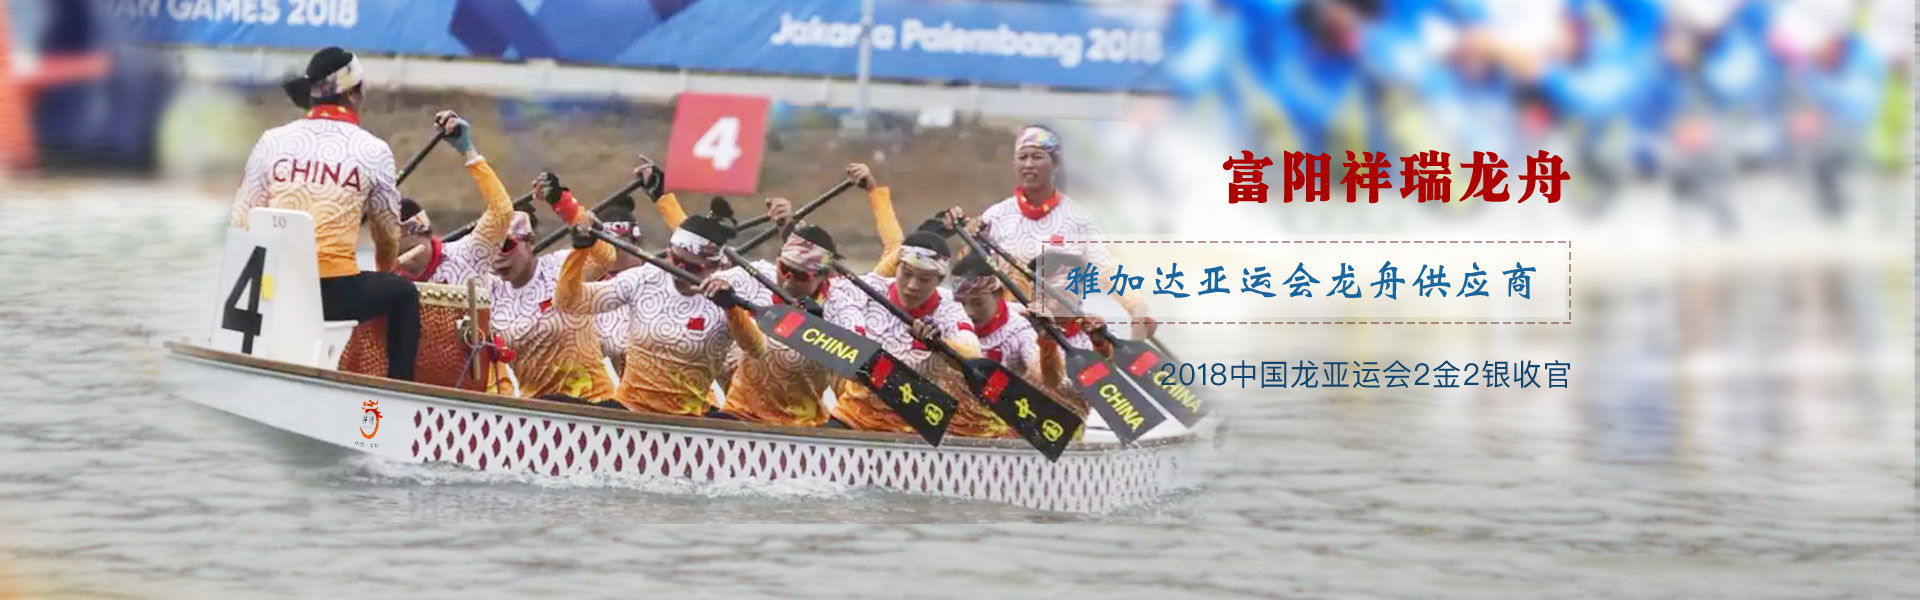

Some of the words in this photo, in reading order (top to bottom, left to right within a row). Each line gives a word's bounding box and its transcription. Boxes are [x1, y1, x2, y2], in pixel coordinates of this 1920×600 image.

[167, 0, 281, 24] GAMES
[286, 0, 359, 28] 2018
[770, 12, 896, 50] Jakara
[901, 18, 1083, 68] Palembang
[1086, 28, 1164, 64] 2018
[692, 117, 742, 171] 4
[273, 158, 361, 191] CHINA
[221, 245, 267, 355] 4
[802, 327, 860, 364] CHINA
[1099, 383, 1146, 432] CHINA
[1153, 370, 1204, 415] CHINA
